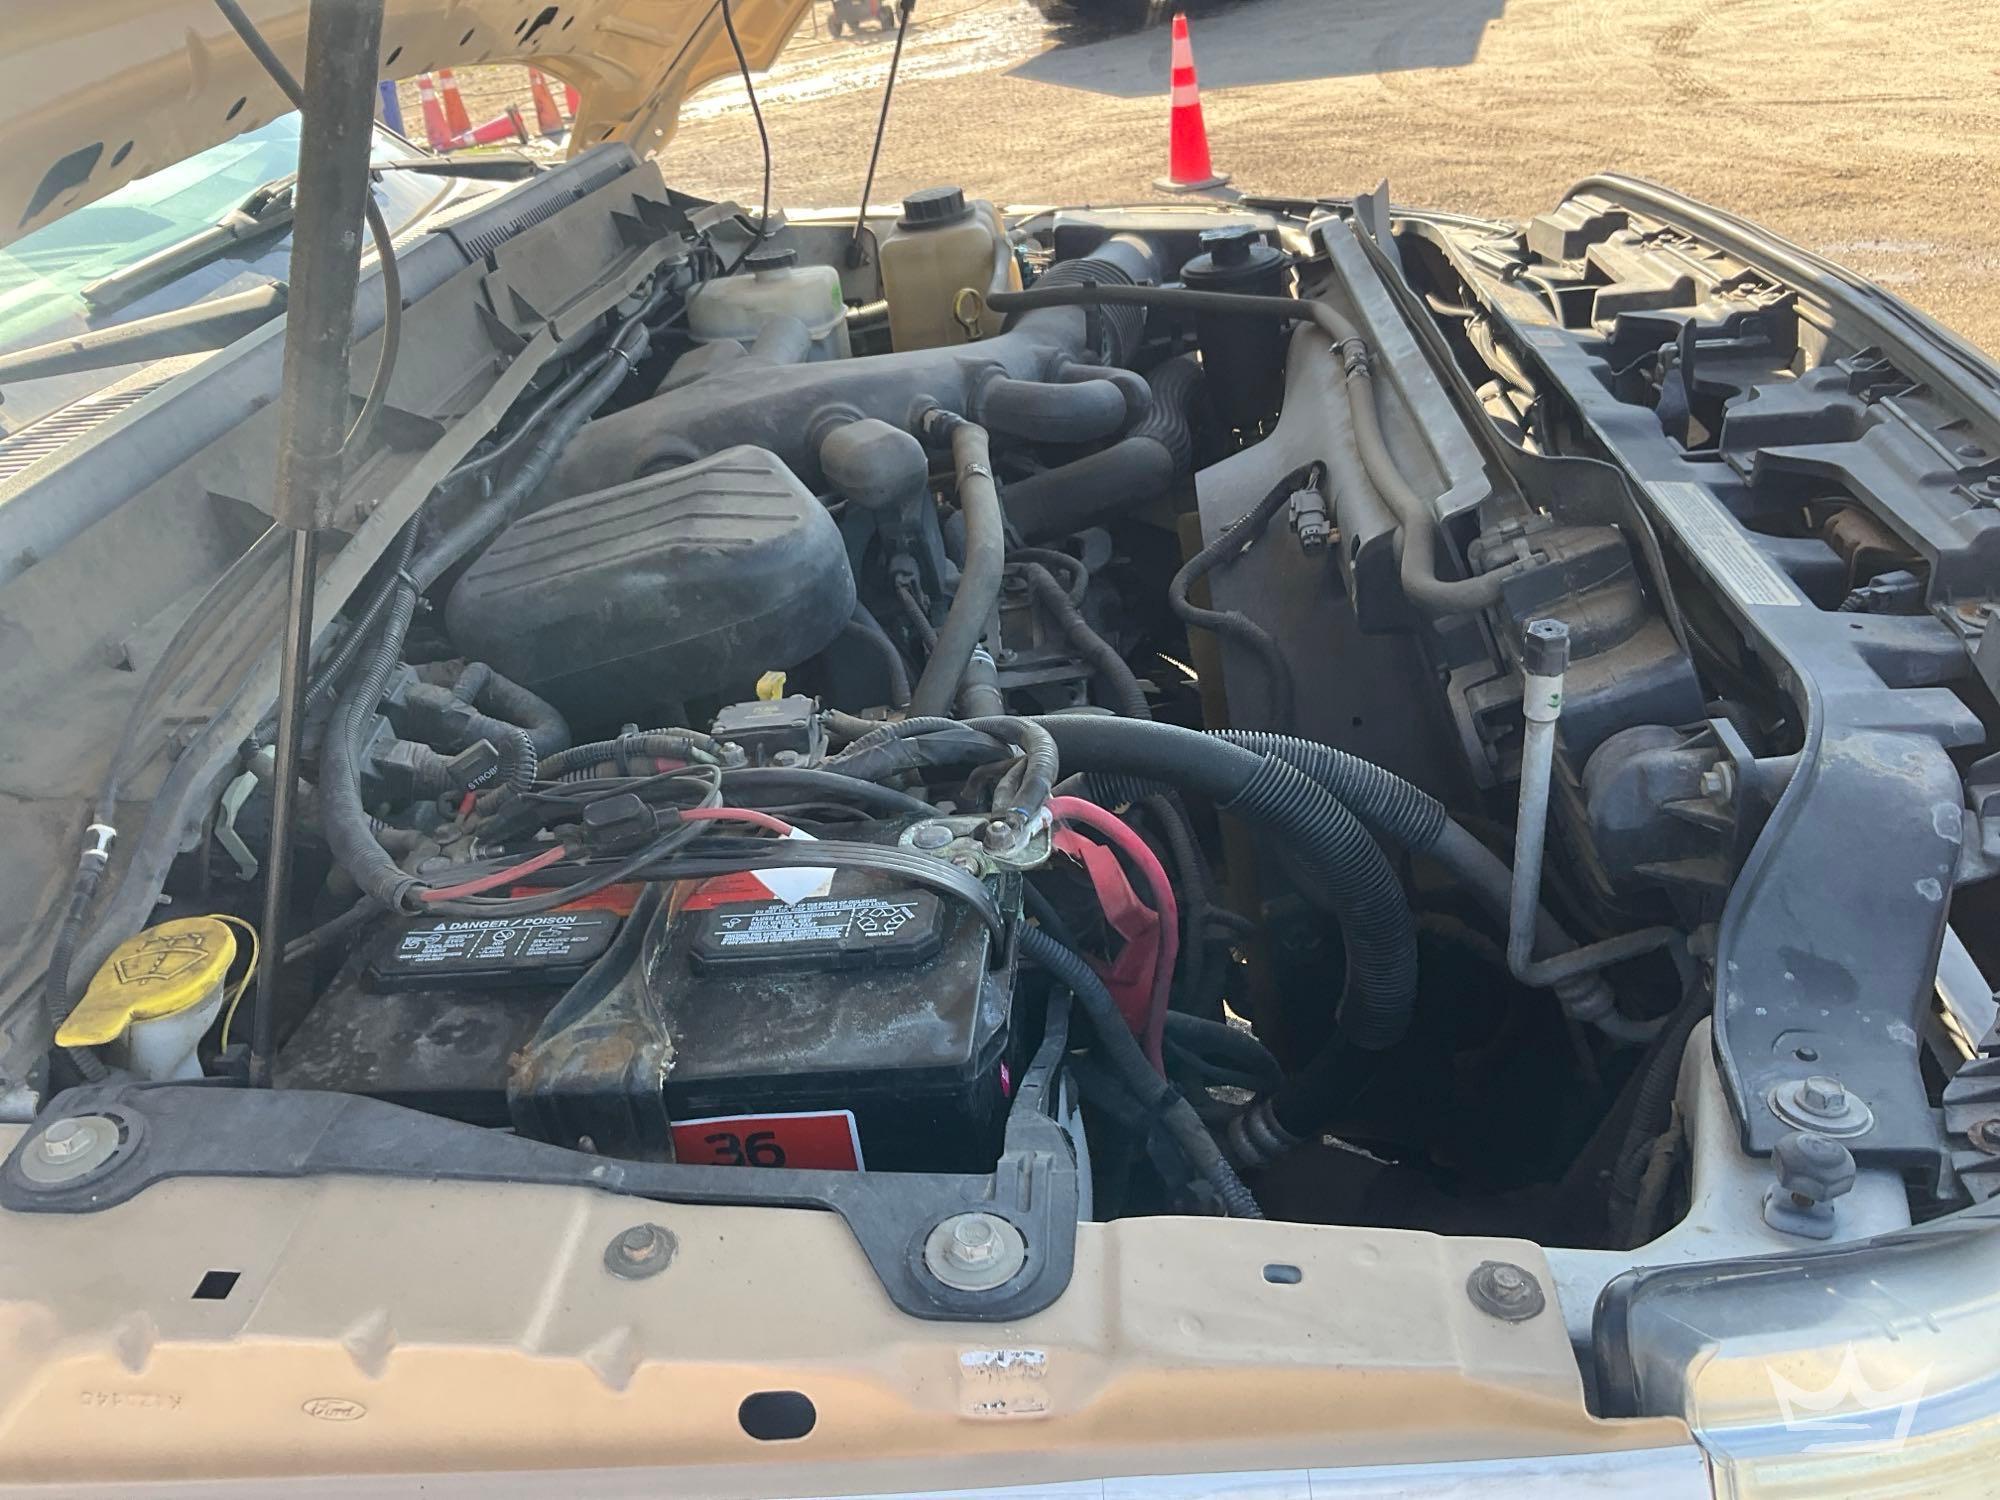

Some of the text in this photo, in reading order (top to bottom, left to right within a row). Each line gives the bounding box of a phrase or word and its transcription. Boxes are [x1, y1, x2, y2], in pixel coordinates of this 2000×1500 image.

[449, 916, 577, 930] DANGER / POISON
[704, 1131, 786, 1167] 36
[309, 1400, 359, 1418] Ford
